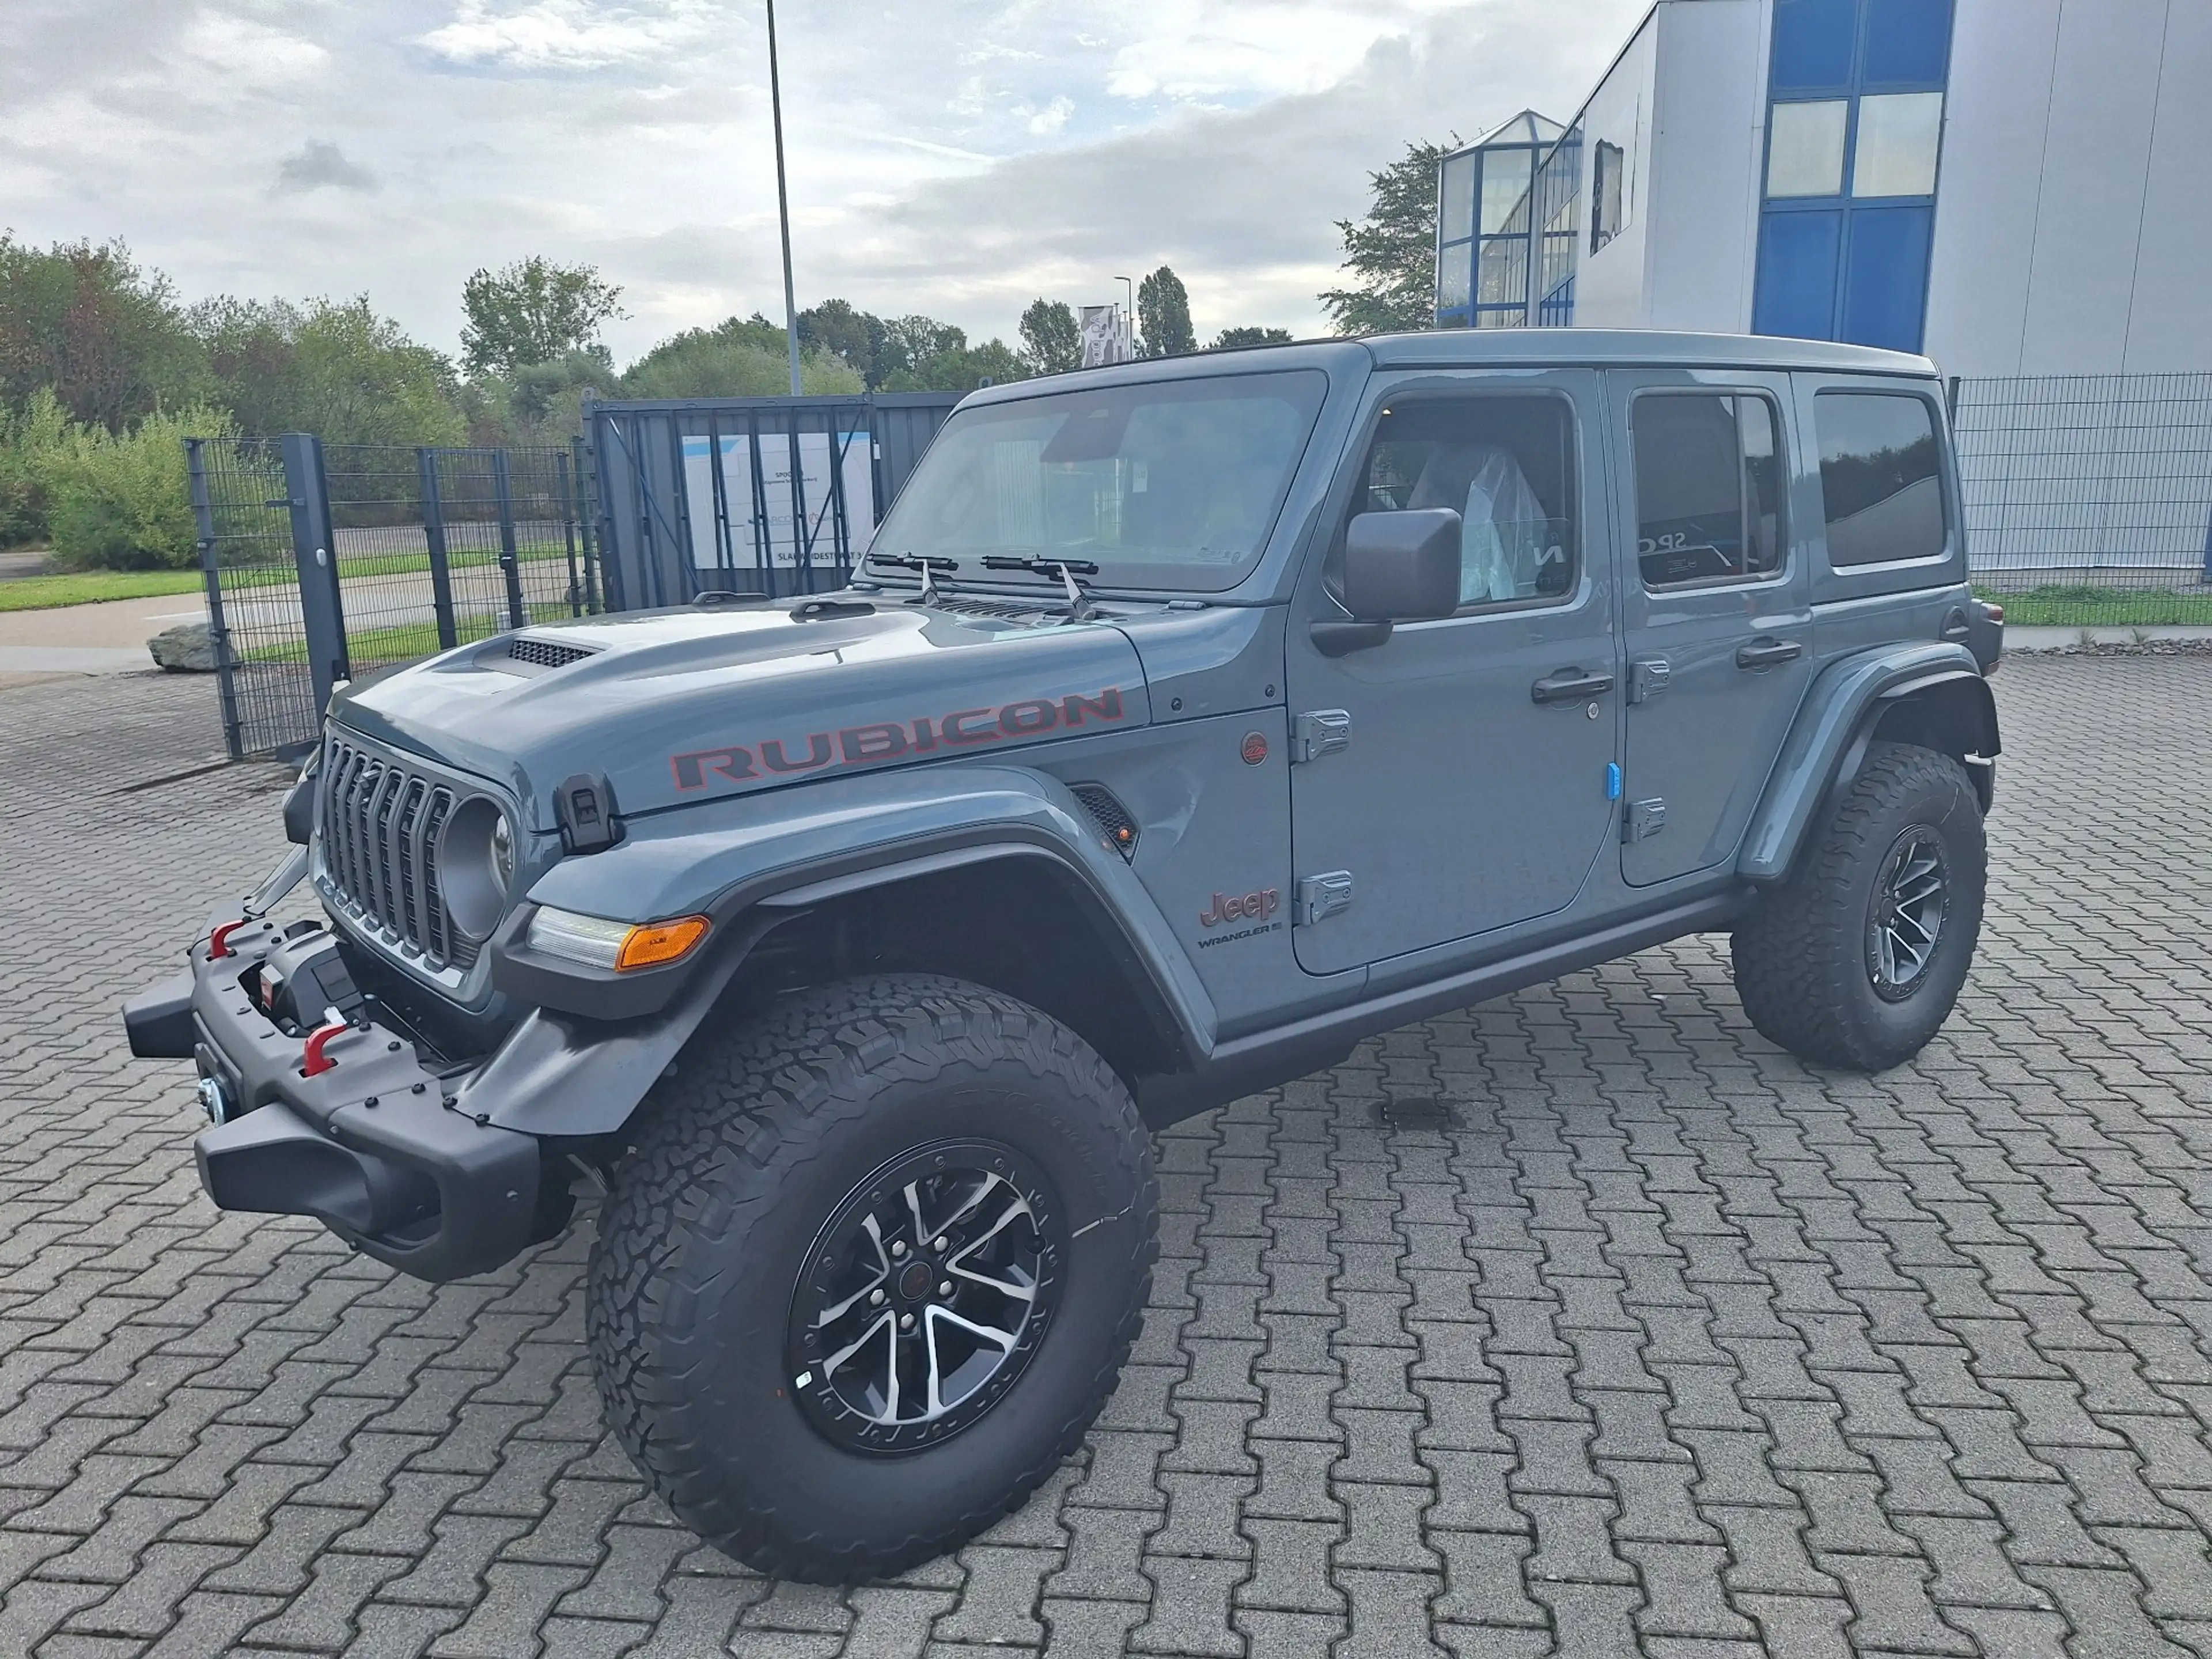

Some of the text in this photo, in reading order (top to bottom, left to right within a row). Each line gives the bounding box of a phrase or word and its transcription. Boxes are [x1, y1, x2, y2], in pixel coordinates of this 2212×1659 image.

[670, 687, 1124, 792] RUBICON
[1200, 888, 1280, 927] Jeep
[1198, 925, 1269, 949] WRANGLER
